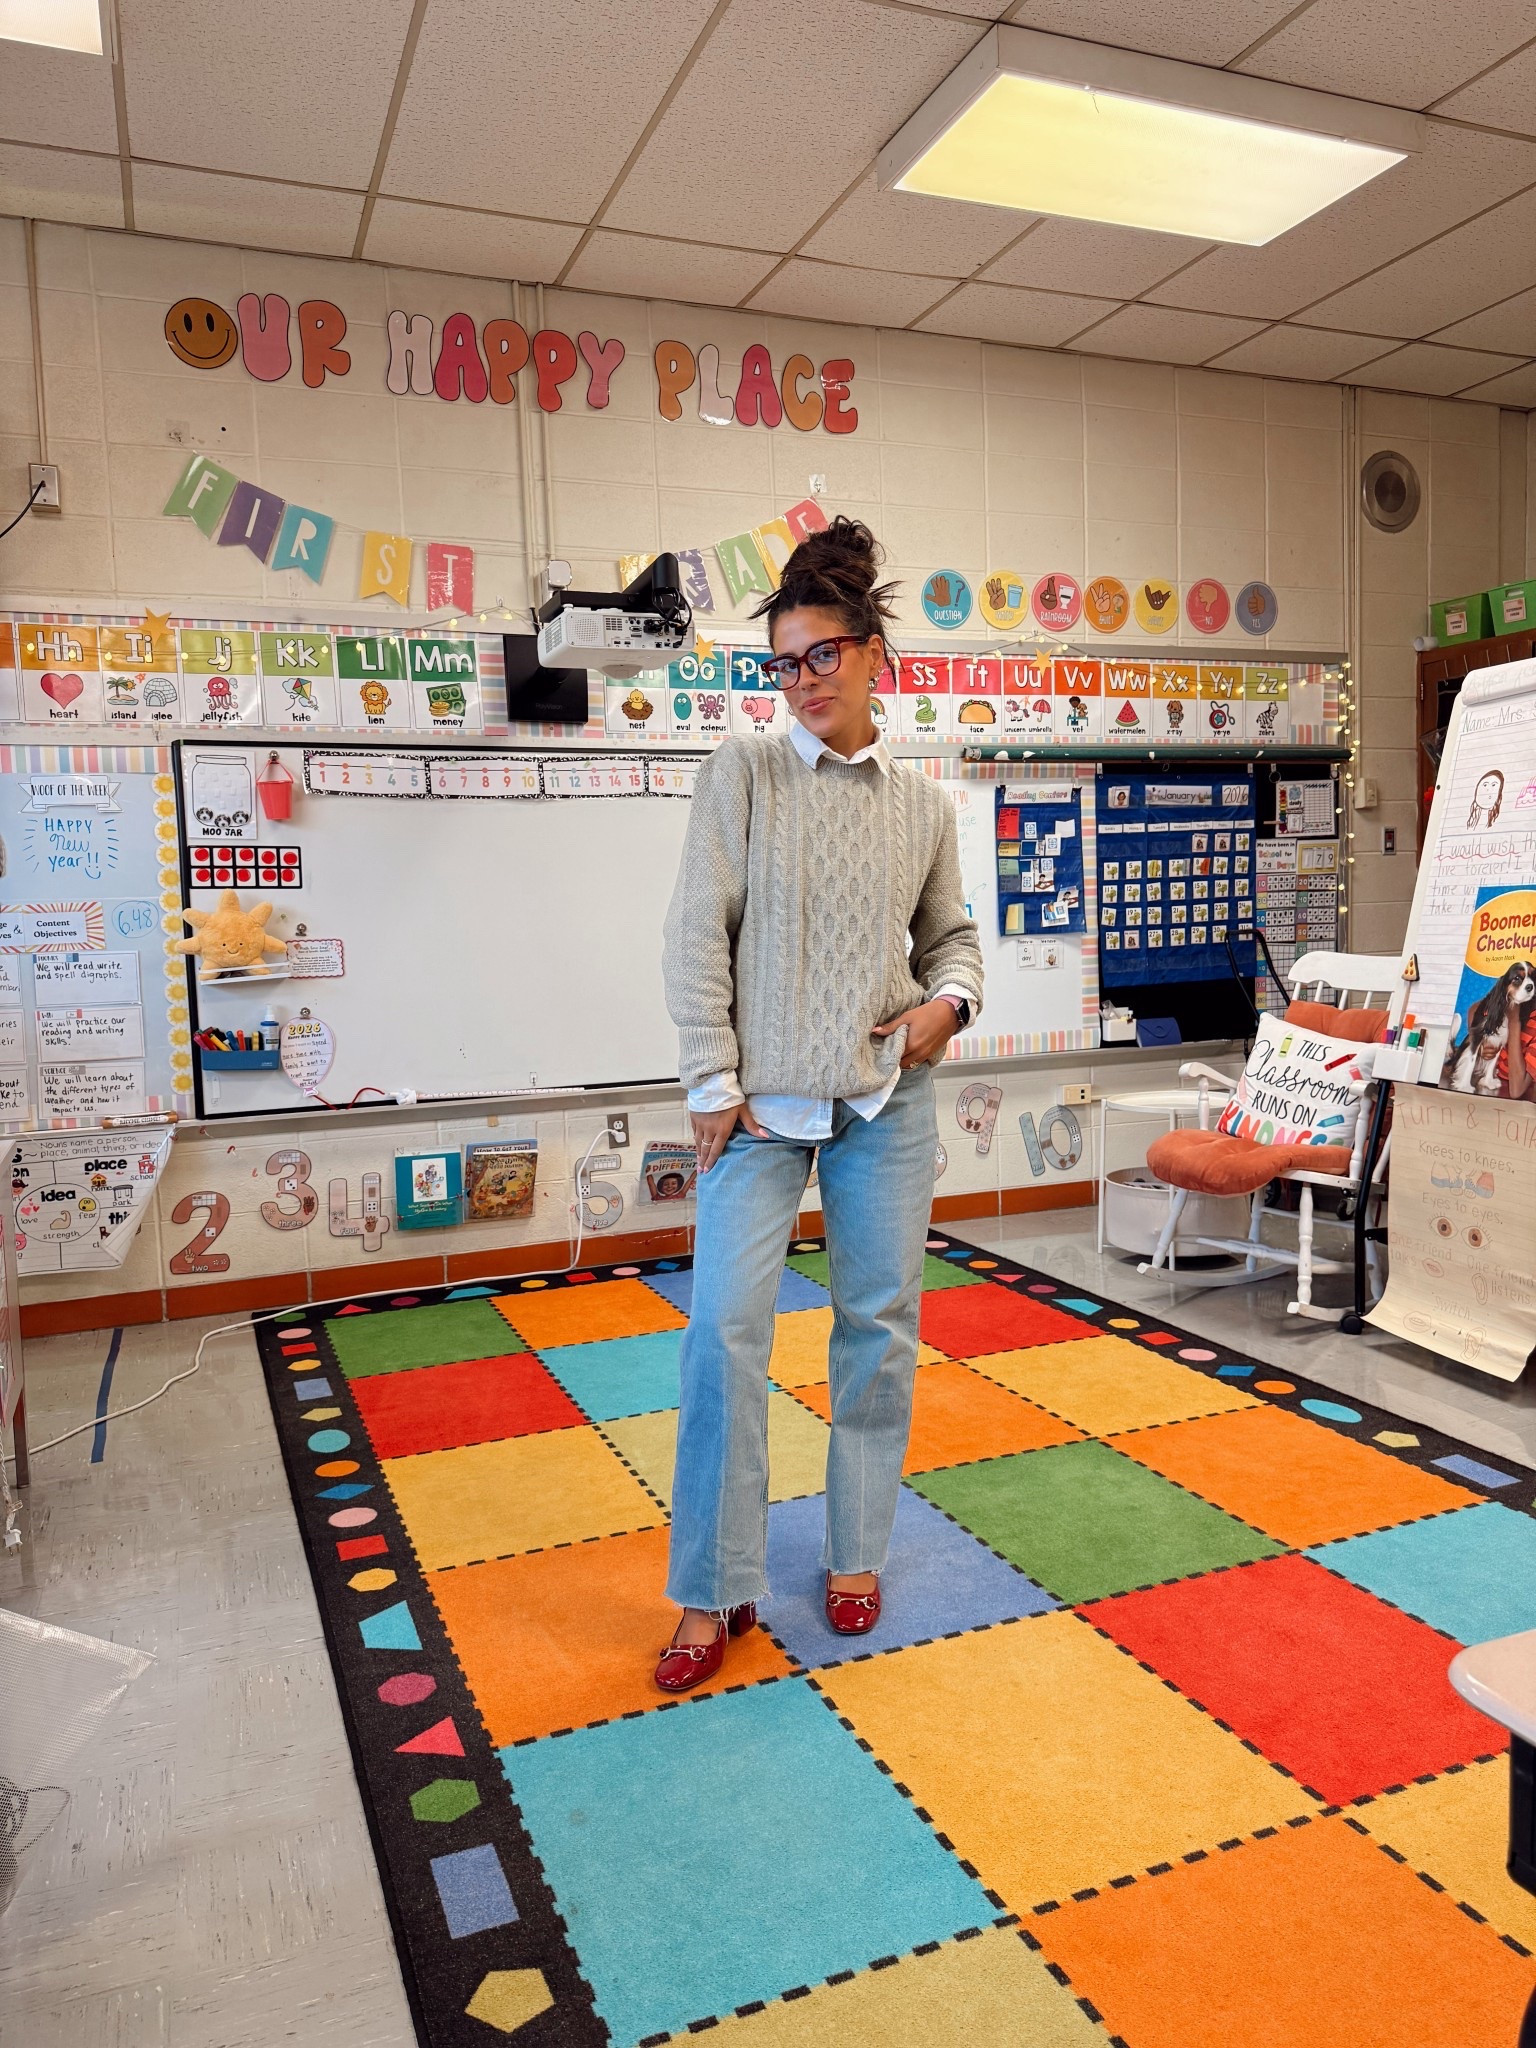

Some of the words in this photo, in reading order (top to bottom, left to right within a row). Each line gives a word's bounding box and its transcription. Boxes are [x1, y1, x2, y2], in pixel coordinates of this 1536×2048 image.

[387, 310, 625, 412] HAPPY
[654, 340, 858, 434] PLACE
[934, 610, 963, 620] QUESTION
[1205, 616, 1213, 625] NO
[1252, 619, 1261, 627] YES
[36, 631, 83, 662] Hh
[125, 632, 153, 663] Ii
[207, 636, 232, 671] Jj
[276, 638, 319, 668] Kk
[360, 642, 384, 671] Ll
[414, 645, 474, 673] Mm
[678, 655, 716, 682] Oo
[911, 662, 938, 687] Ss
[966, 664, 988, 688] Tt
[1014, 665, 1043, 688] Uu
[1064, 666, 1093, 689] Vv
[1107, 668, 1147, 691] Ww
[1162, 670, 1189, 692] Xx
[1256, 672, 1279, 694] Zz
[1209, 671, 1234, 698] Yy
[50, 709, 78, 719] heart
[111, 711, 136, 720] island
[151, 712, 173, 721] igloo
[200, 711, 243, 723] jellyfish
[292, 712, 311, 722] kite
[368, 716, 385, 725] lion
[1463, 711, 1495, 732] Name:
[1498, 706, 1525, 726] Mrs.
[433, 717, 463, 727] money
[629, 722, 645, 730] nest
[700, 723, 727, 733] octopus
[754, 724, 765, 733] pig
[916, 725, 936, 733] snake
[1258, 728, 1275, 736] zebra
[319, 771, 325, 782] 1
[343, 773, 350, 784] 2
[365, 773, 373, 785] 3
[387, 774, 396, 786] 4
[410, 775, 418, 787] 5
[439, 775, 446, 787] 6
[460, 776, 467, 787] 7
[482, 776, 489, 788] 8
[504, 775, 511, 787] 9
[522, 775, 534, 787] 10
[549, 775, 560, 787] 11
[569, 775, 581, 787] 12
[588, 775, 601, 787] 13
[608, 775, 621, 787] 14
[630, 775, 640, 786] 15
[654, 775, 664, 786] 16
[673, 775, 683, 787] 17
[31, 785, 54, 796] WOOF
[58, 785, 67, 796] OF
[71, 785, 83, 796] THE
[87, 785, 108, 796] WEEK
[1007, 791, 1036, 802] Reading
[1039, 791, 1068, 799] Centers
[1161, 789, 1195, 803] January
[1223, 786, 1248, 803] 2026
[45, 818, 92, 833] HAPPY
[202, 827, 222, 836] MOO
[224, 828, 243, 837] JAR
[50, 834, 89, 852] New
[1451, 837, 1480, 856] would
[1488, 834, 1514, 854] wish
[1432, 880, 1456, 895] time
[1430, 900, 1452, 915] take
[34, 930, 77, 938] Objectives
[36, 972, 51, 980] and
[55, 971, 75, 981] spell
[76, 1017, 107, 1029] practice
[289, 1023, 321, 1035] 2026
[42, 1028, 71, 1038] reading
[76, 1027, 93, 1035] and
[95, 1027, 124, 1036] writing
[1297, 1040, 1331, 1061] THIS
[45, 1076, 60, 1085] We
[65, 1074, 81, 1083] will
[111, 1072, 134, 1081] about
[1244, 1040, 1359, 1106] Classroom
[45, 1086, 57, 1095] the
[62, 1085, 97, 1095] different
[101, 1084, 121, 1095] types
[126, 1082, 135, 1090] of
[1252, 1090, 1290, 1119] RUNS
[1292, 1104, 1317, 1127] ON
[1395, 1102, 1453, 1129] Turn
[1467, 1103, 1479, 1129] &
[956, 1083, 1003, 1154] 9
[1216, 1100, 1344, 1146] KINDN
[40, 1141, 67, 1149] Nouns
[71, 1138, 93, 1147] name
[1019, 1105, 1082, 1176] 10
[1419, 1140, 1454, 1160] Knees
[1459, 1148, 1471, 1163] to
[1475, 1151, 1514, 1174] knees.
[84, 1159, 128, 1174] place
[653, 1161, 697, 1172] DIFFERENT
[130, 1173, 154, 1181] school
[41, 1189, 76, 1202] idea
[261, 1150, 318, 1230] 3
[575, 1154, 623, 1229] 5
[329, 1172, 390, 1252] 4
[1422, 1192, 1450, 1210] Eyes
[1456, 1200, 1467, 1214] to
[1472, 1207, 1503, 1225] eyes.
[20, 1216, 39, 1224] love
[278, 1219, 303, 1228] three
[43, 1231, 80, 1240] strength
[170, 1191, 230, 1274] 2
[340, 1226, 360, 1235] four
[1390, 1232, 1412, 1246] One
[1416, 1241, 1452, 1261] friend
[1391, 1249, 1417, 1265] talks
[192, 1264, 209, 1272] two
[1467, 1254, 1490, 1274] One
[1495, 1265, 1534, 1288] friend
[1434, 1296, 1472, 1321] Switch.
